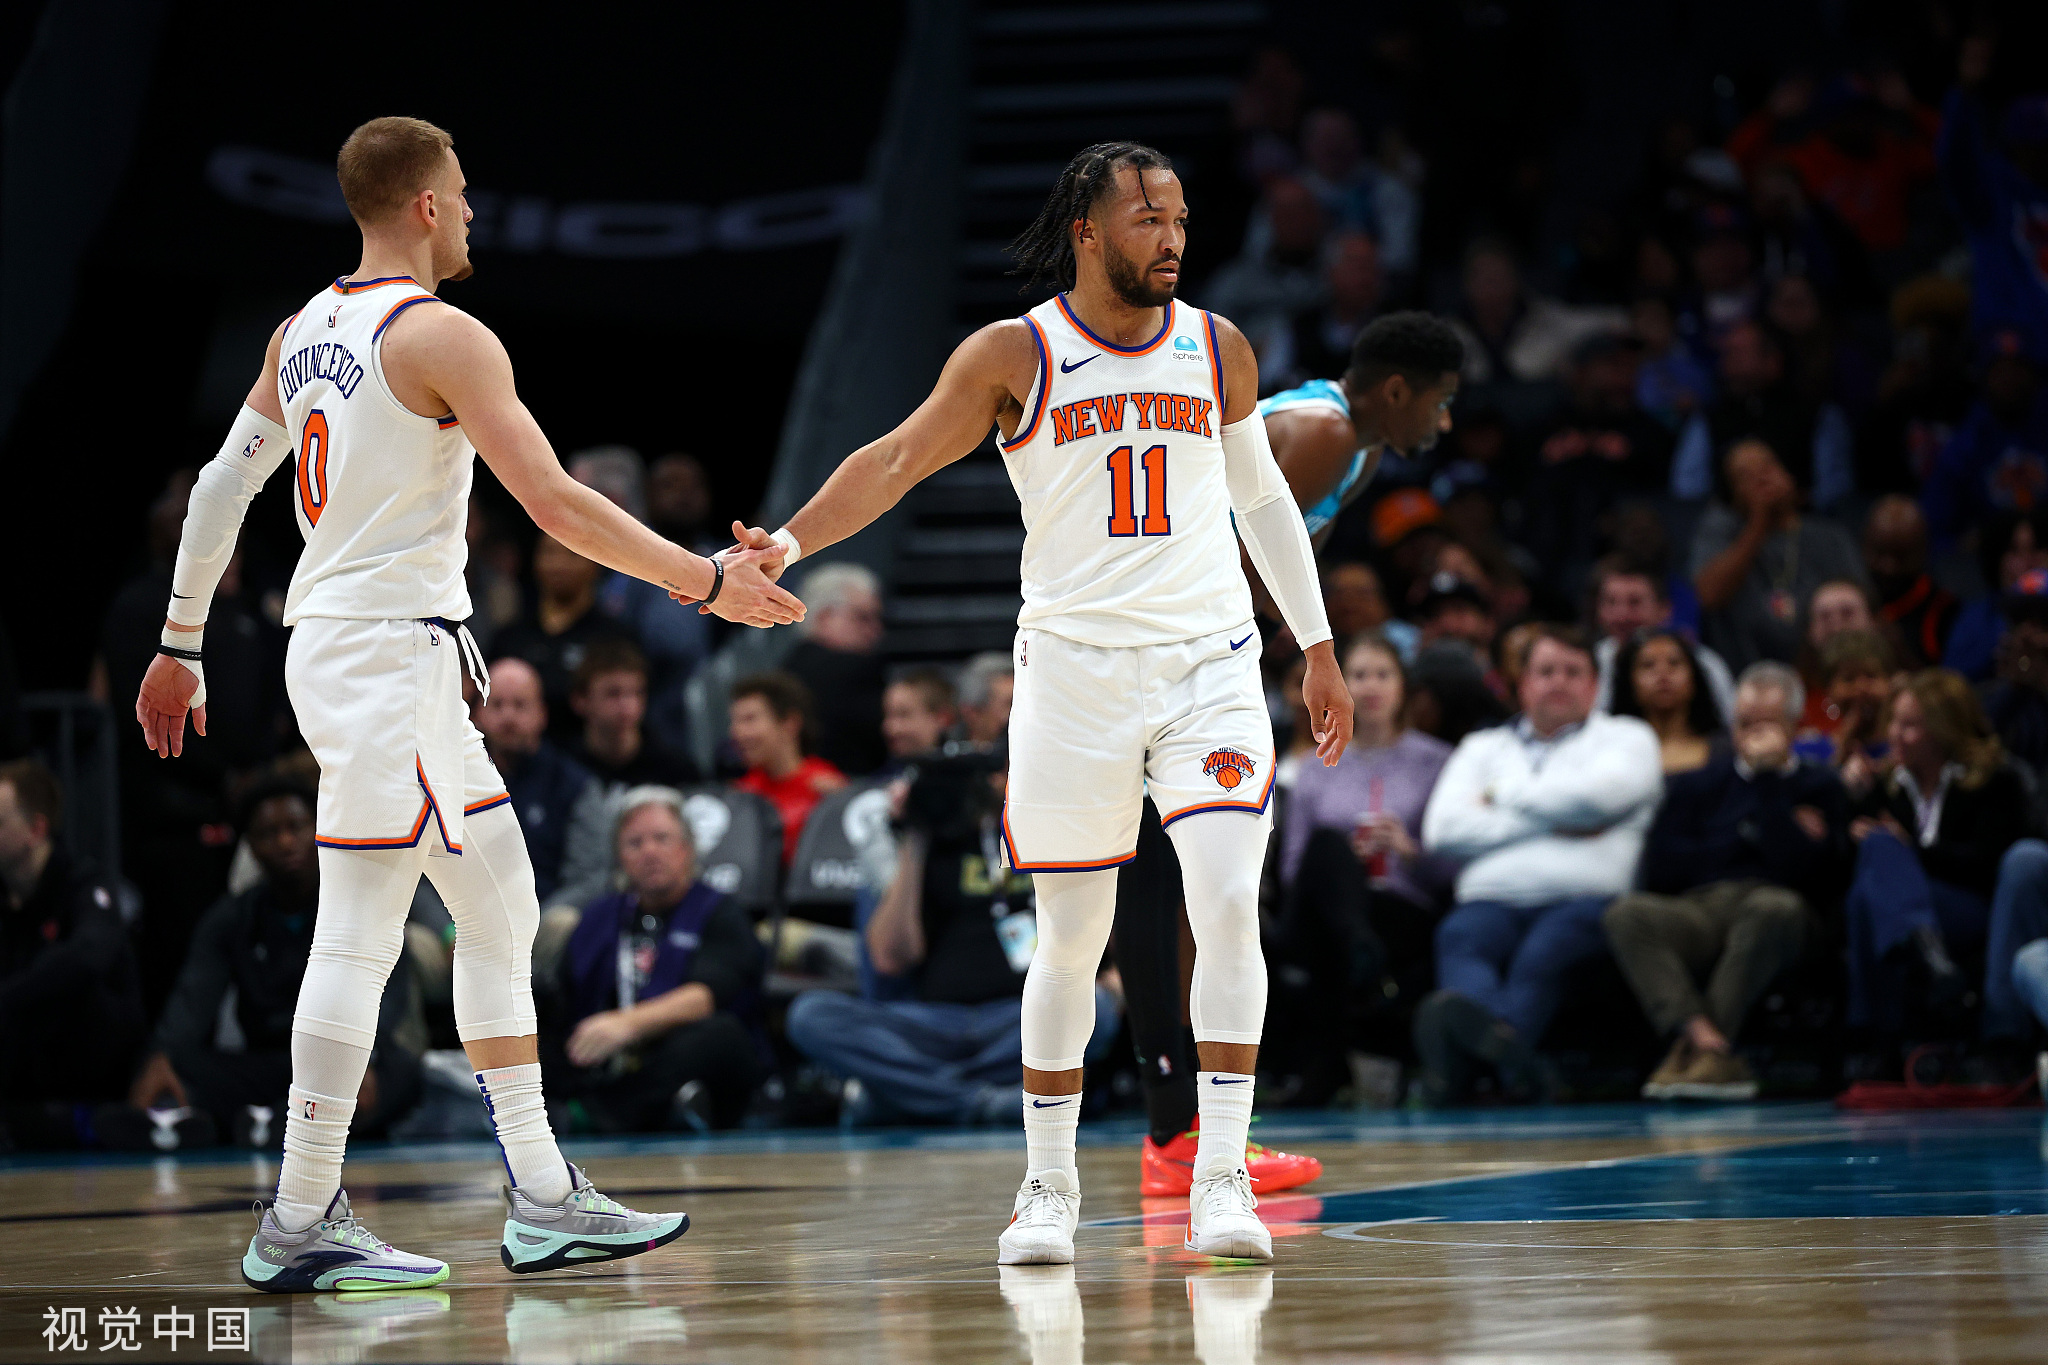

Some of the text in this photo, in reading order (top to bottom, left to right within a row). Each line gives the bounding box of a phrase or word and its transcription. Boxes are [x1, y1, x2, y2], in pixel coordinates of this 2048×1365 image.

[1172, 352, 1204, 361] sphere
[1051, 392, 1212, 447] NEW YORK
[297, 408, 329, 530] 0
[1107, 445, 1171, 537] 11
[1203, 751, 1254, 777] KNICKS
